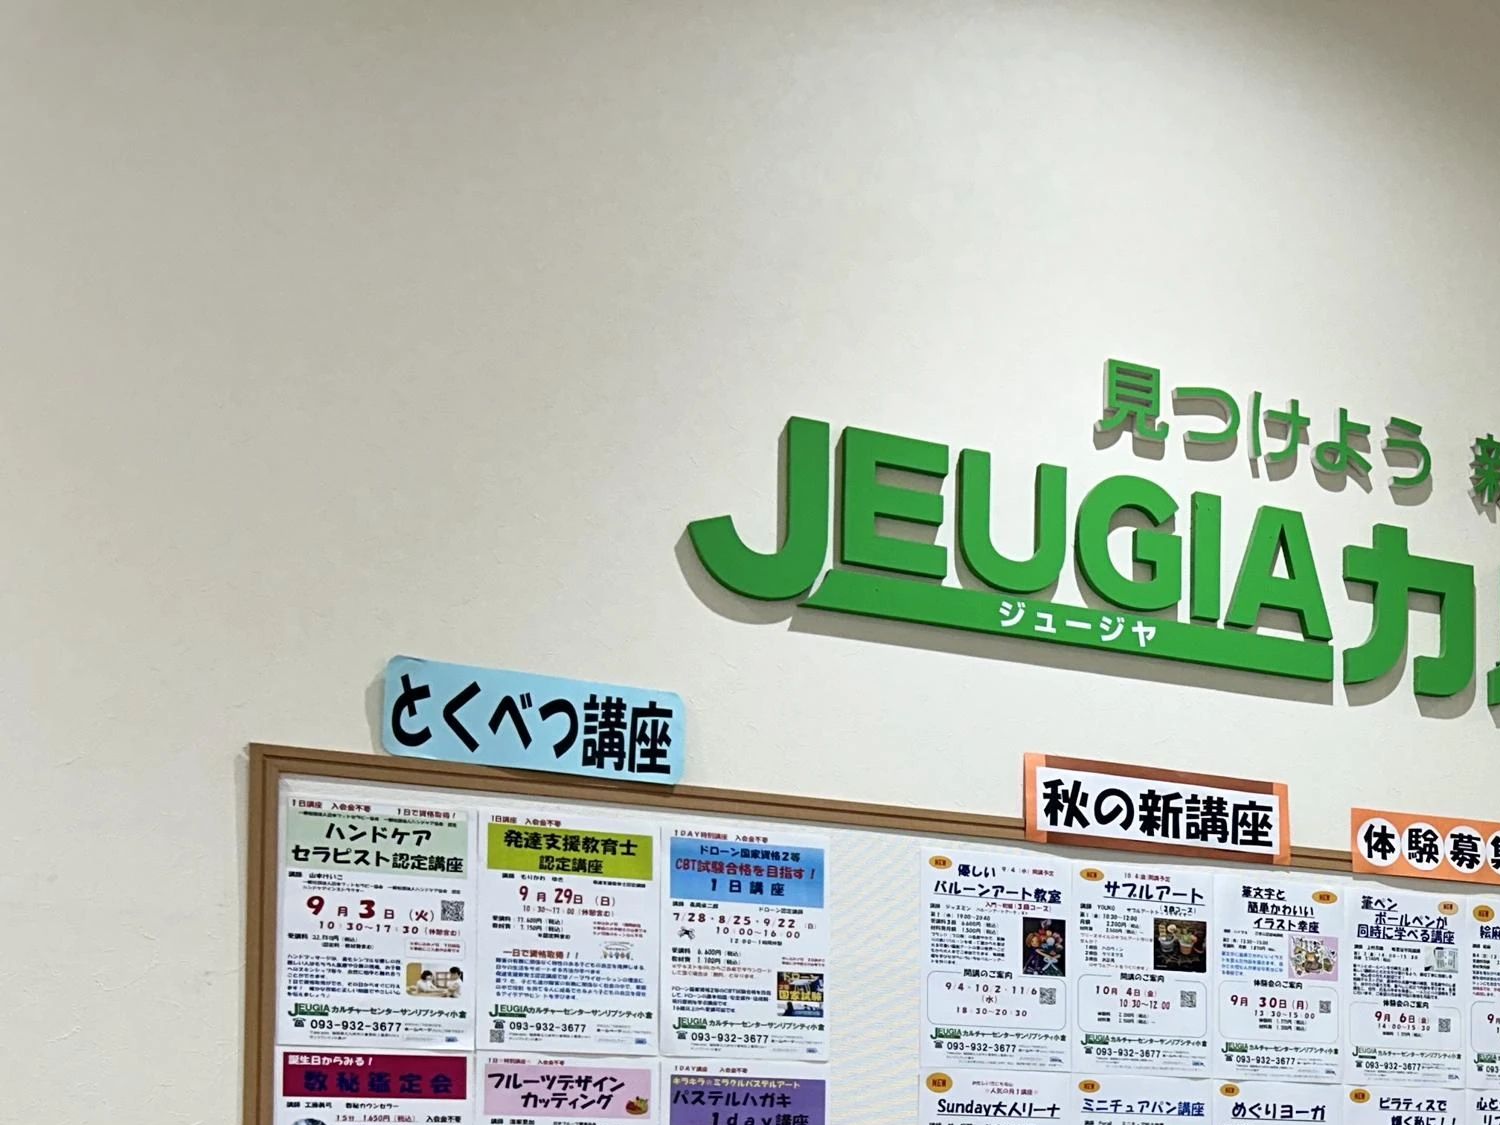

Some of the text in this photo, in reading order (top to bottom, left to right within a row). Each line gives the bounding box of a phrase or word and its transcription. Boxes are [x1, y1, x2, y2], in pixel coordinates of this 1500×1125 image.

[1100, 358, 1432, 486] 見つけよう
[391, 673, 673, 775] とくべつ講座
[1042, 779, 1274, 847] 秋の新講座
[325, 823, 431, 847] ハンドケア
[504, 829, 638, 856] 発達支援教育士
[292, 844, 464, 873] セラピスト認定講座
[700, 844, 801, 862] ドローン国家資格2等
[539, 855, 603, 874] 認定講座
[675, 857, 816, 880] CBT試験合格を目指す！
[958, 864, 996, 878] 優しい
[711, 878, 785, 897] 1日講座
[934, 880, 1062, 904] バルーンアート教室
[1361, 895, 1397, 910] 筆ペン
[1375, 912, 1448, 929] ボールペンが
[1358, 924, 1455, 944] 同時に学べる講座
[310, 1019, 402, 1032] 093-932-3677
[509, 1021, 587, 1033] 093-932-3677
[691, 1032, 769, 1043] 093-932-3677
[947, 1041, 1016, 1053] 093-932-3677
[1096, 1047, 1160, 1058] 093-932-3677
[288, 1054, 374, 1067] 誕生日からみる！
[1236, 1055, 1295, 1065] 093-932-3677
[1365, 1061, 1421, 1071] 093-932-3677
[303, 1070, 453, 1094] 数秘鑑定会
[487, 1072, 625, 1092] フルーツデザイン
[521, 1092, 613, 1110] カッティング
[672, 1090, 792, 1108] パステルハガキ
[1081, 1098, 1205, 1117] ミニチュアパン講座
[1379, 1097, 1447, 1112] ピラティスで
[1232, 1102, 1326, 1120] めぐりヨーガ
